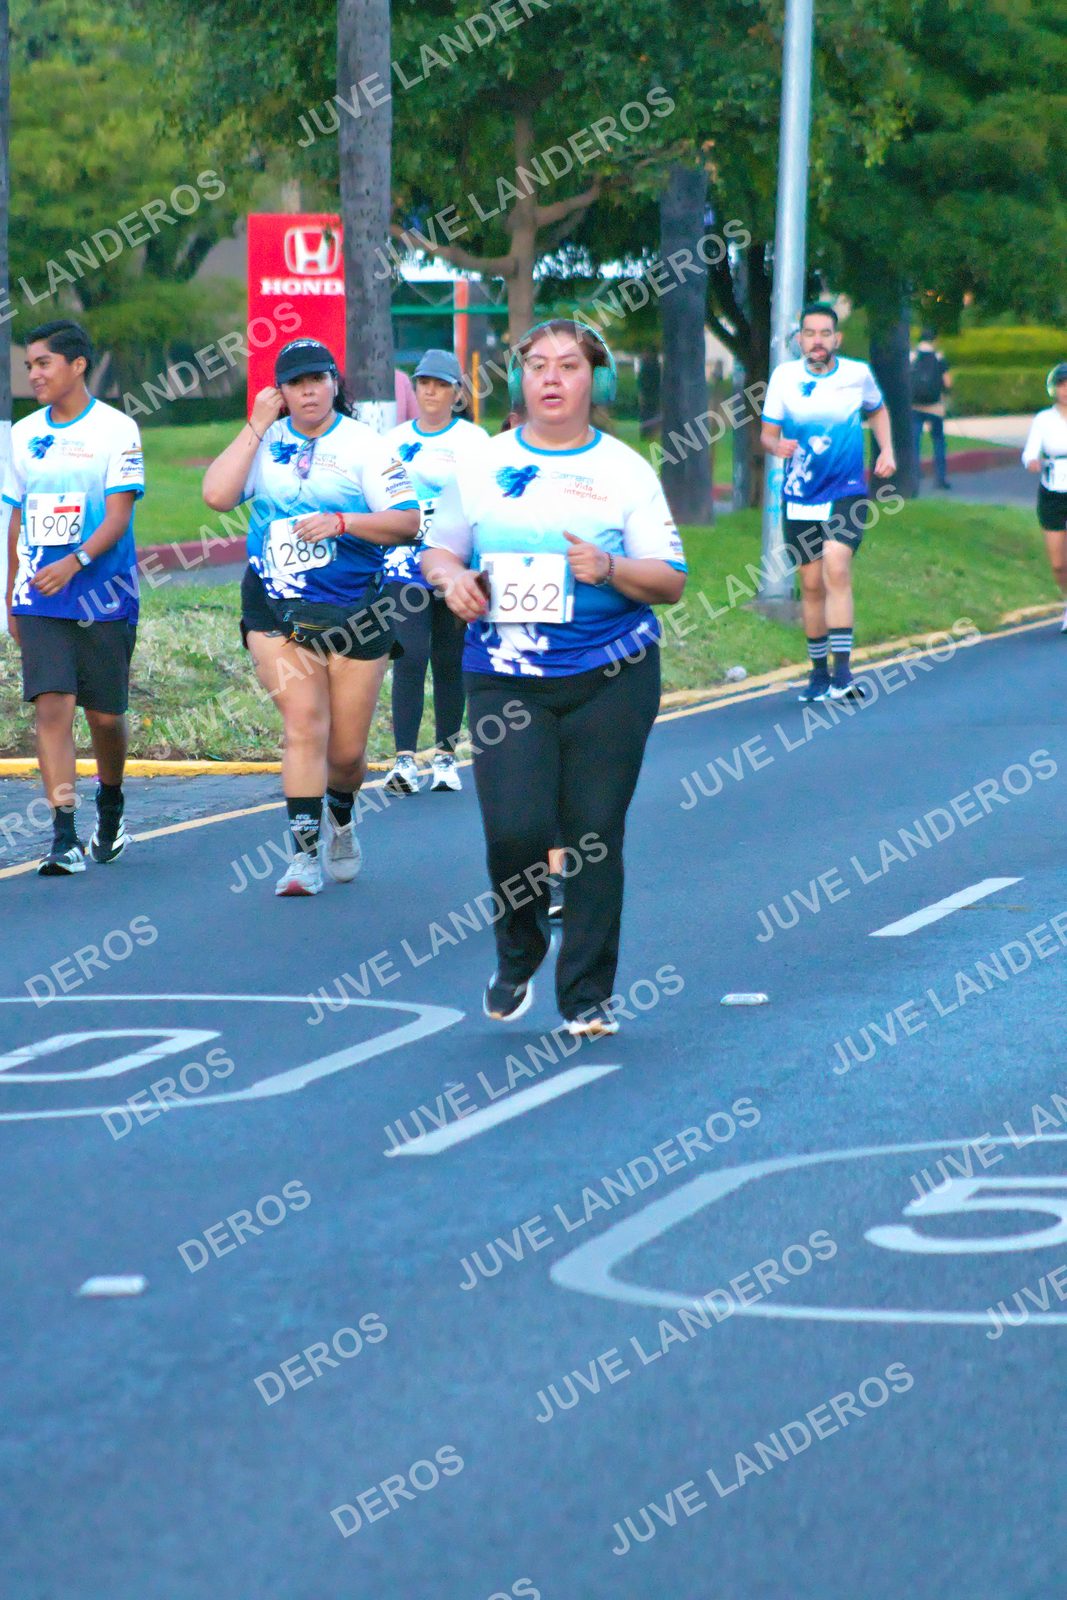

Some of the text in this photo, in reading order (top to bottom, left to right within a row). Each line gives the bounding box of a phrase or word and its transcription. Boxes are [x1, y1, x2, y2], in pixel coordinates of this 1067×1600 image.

[260, 278, 345, 296] HOND
[30, 514, 81, 538] 1906
[268, 539, 327, 569] 1286
[499, 583, 560, 612] 562
